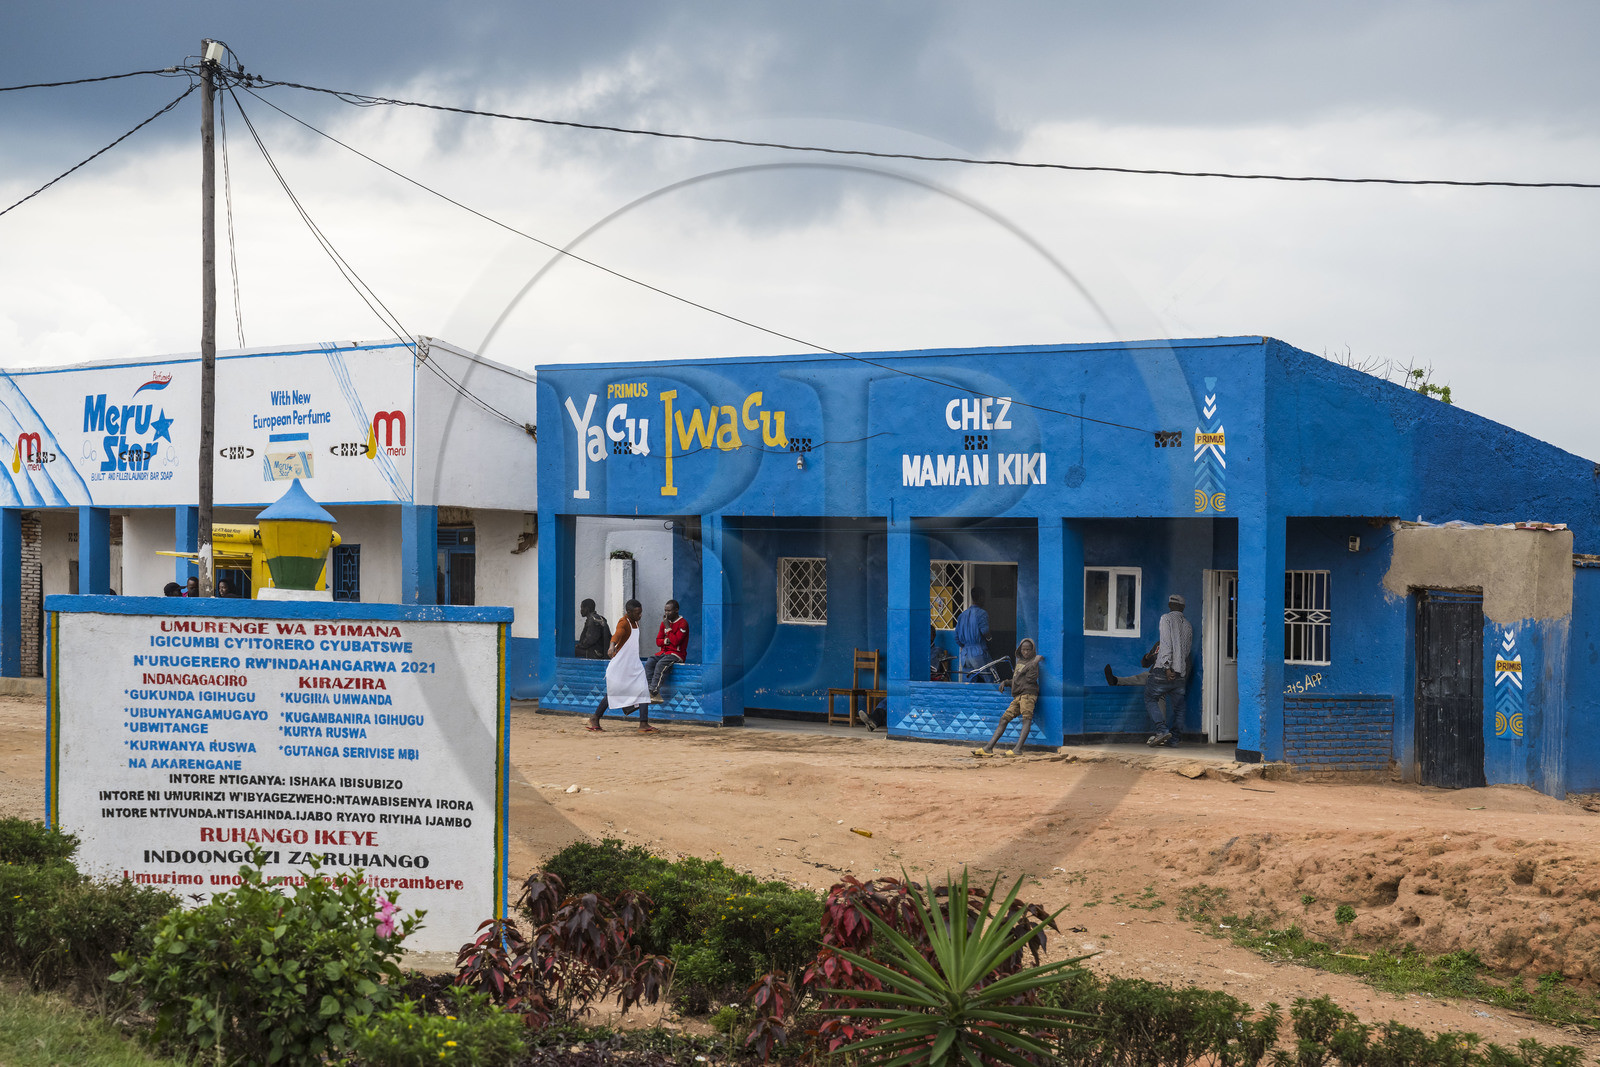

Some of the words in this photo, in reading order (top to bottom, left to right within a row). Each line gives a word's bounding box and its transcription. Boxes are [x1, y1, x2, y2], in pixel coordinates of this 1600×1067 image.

[271, 391, 290, 406] With
[293, 390, 311, 405] New
[607, 382, 648, 399] PRIMUS
[83, 394, 153, 435] Meru
[253, 413, 291, 431] European
[293, 409, 331, 426] Perfume
[945, 397, 1012, 430] CHEZ
[564, 394, 650, 499] Yacu
[660, 389, 789, 496] Iwacu
[1197, 434, 1224, 444] PRIMUS
[100, 436, 158, 472] Star
[386, 447, 406, 457] meru
[91, 472, 106, 481] BUILT
[150, 472, 159, 480] BAR
[161, 471, 173, 480] SOAP
[902, 454, 989, 487] MAMAN
[998, 452, 1047, 485] KIKI
[160, 620, 270, 634] UMURENGE
[276, 623, 307, 635] WA
[314, 624, 402, 637] BYIMANA
[150, 635, 219, 648] IGICUMBI
[224, 637, 315, 651] CY'ITORERO
[320, 640, 413, 653] CYUBATSWE
[133, 655, 240, 668] N'URUGERERO
[245, 657, 397, 672] RW'INDAHANGARWA
[401, 662, 435, 673] 2021
[1496, 662, 1522, 671] PRIMUS
[143, 673, 248, 687] INDANGAGACIRO
[299, 676, 387, 690] KIRAZIRA
[199, 691, 256, 702] IGIHUGU
[333, 693, 392, 705] UMWANDA
[374, 714, 424, 726] IGIHUGU
[326, 727, 367, 739] RUSWA
[209, 741, 257, 753] RUSWA
[343, 747, 394, 760] SERIVISE
[398, 748, 419, 761] MBI
[128, 758, 147, 768] NA
[151, 758, 242, 770] AKARENGANE
[169, 773, 215, 784] INTORE
[219, 774, 286, 786] NTIGANYA:
[289, 776, 336, 787] ISHAKA
[340, 777, 403, 790] IBISUBIZO
[99, 790, 145, 801] INTORE
[147, 791, 160, 801] NI
[164, 791, 226, 801] UMURINZI
[436, 799, 474, 811] IRORA
[102, 807, 148, 818] INTORE
[336, 811, 375, 823] RYAYO
[379, 813, 422, 826] RIYIHA
[425, 815, 472, 828] IJAMBO
[200, 827, 309, 845] RUHANGO
[314, 829, 379, 847] IKEYE
[288, 851, 313, 865] ZA
[322, 852, 429, 869] RUHANGO
